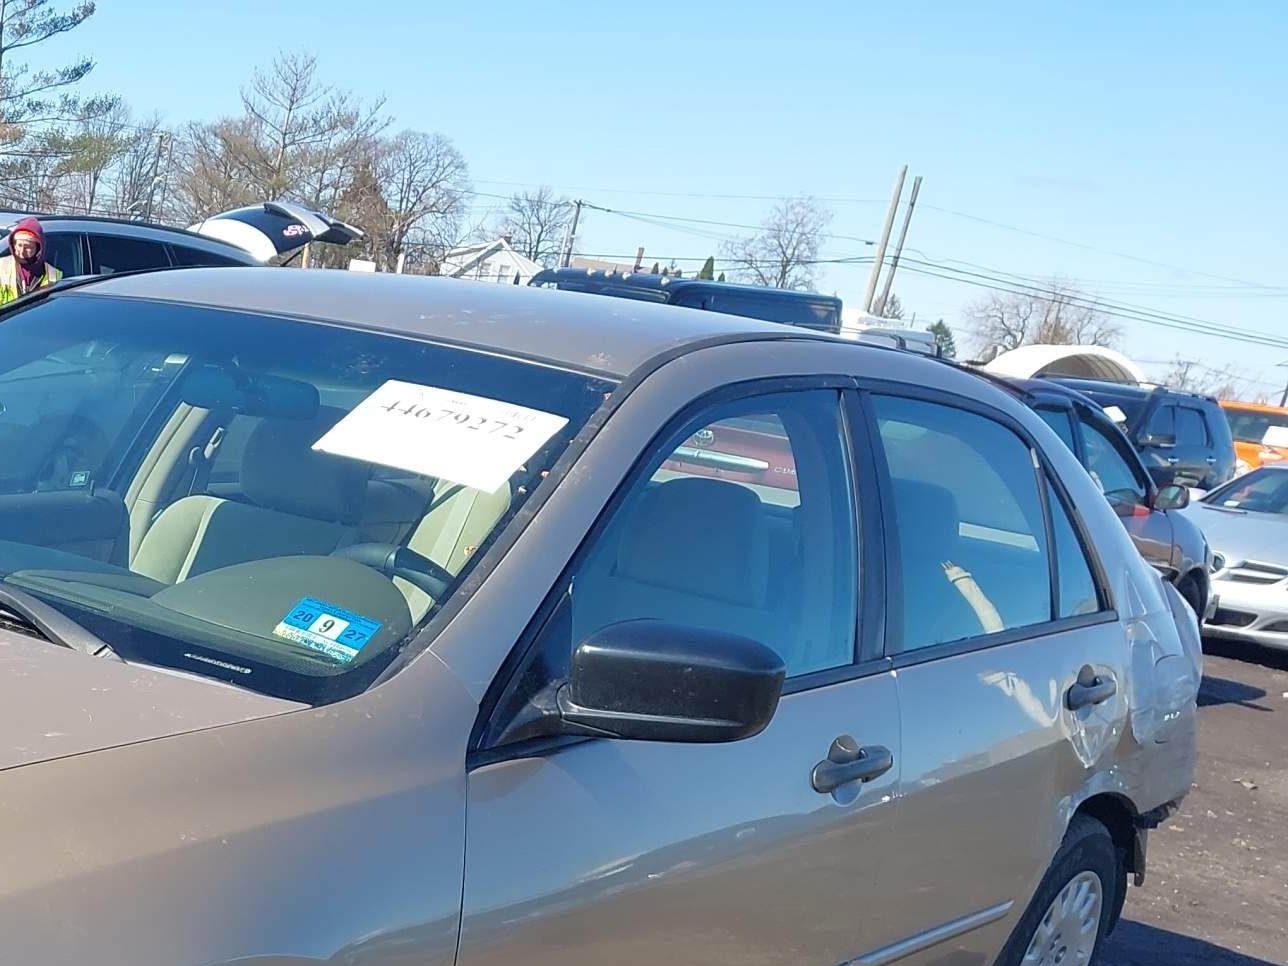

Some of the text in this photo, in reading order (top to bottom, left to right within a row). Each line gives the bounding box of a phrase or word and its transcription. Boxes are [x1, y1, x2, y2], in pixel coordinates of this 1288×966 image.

[380, 401, 524, 439] 44679272
[293, 610, 314, 623] 20
[318, 619, 335, 633] 9
[343, 629, 366, 642] 27
